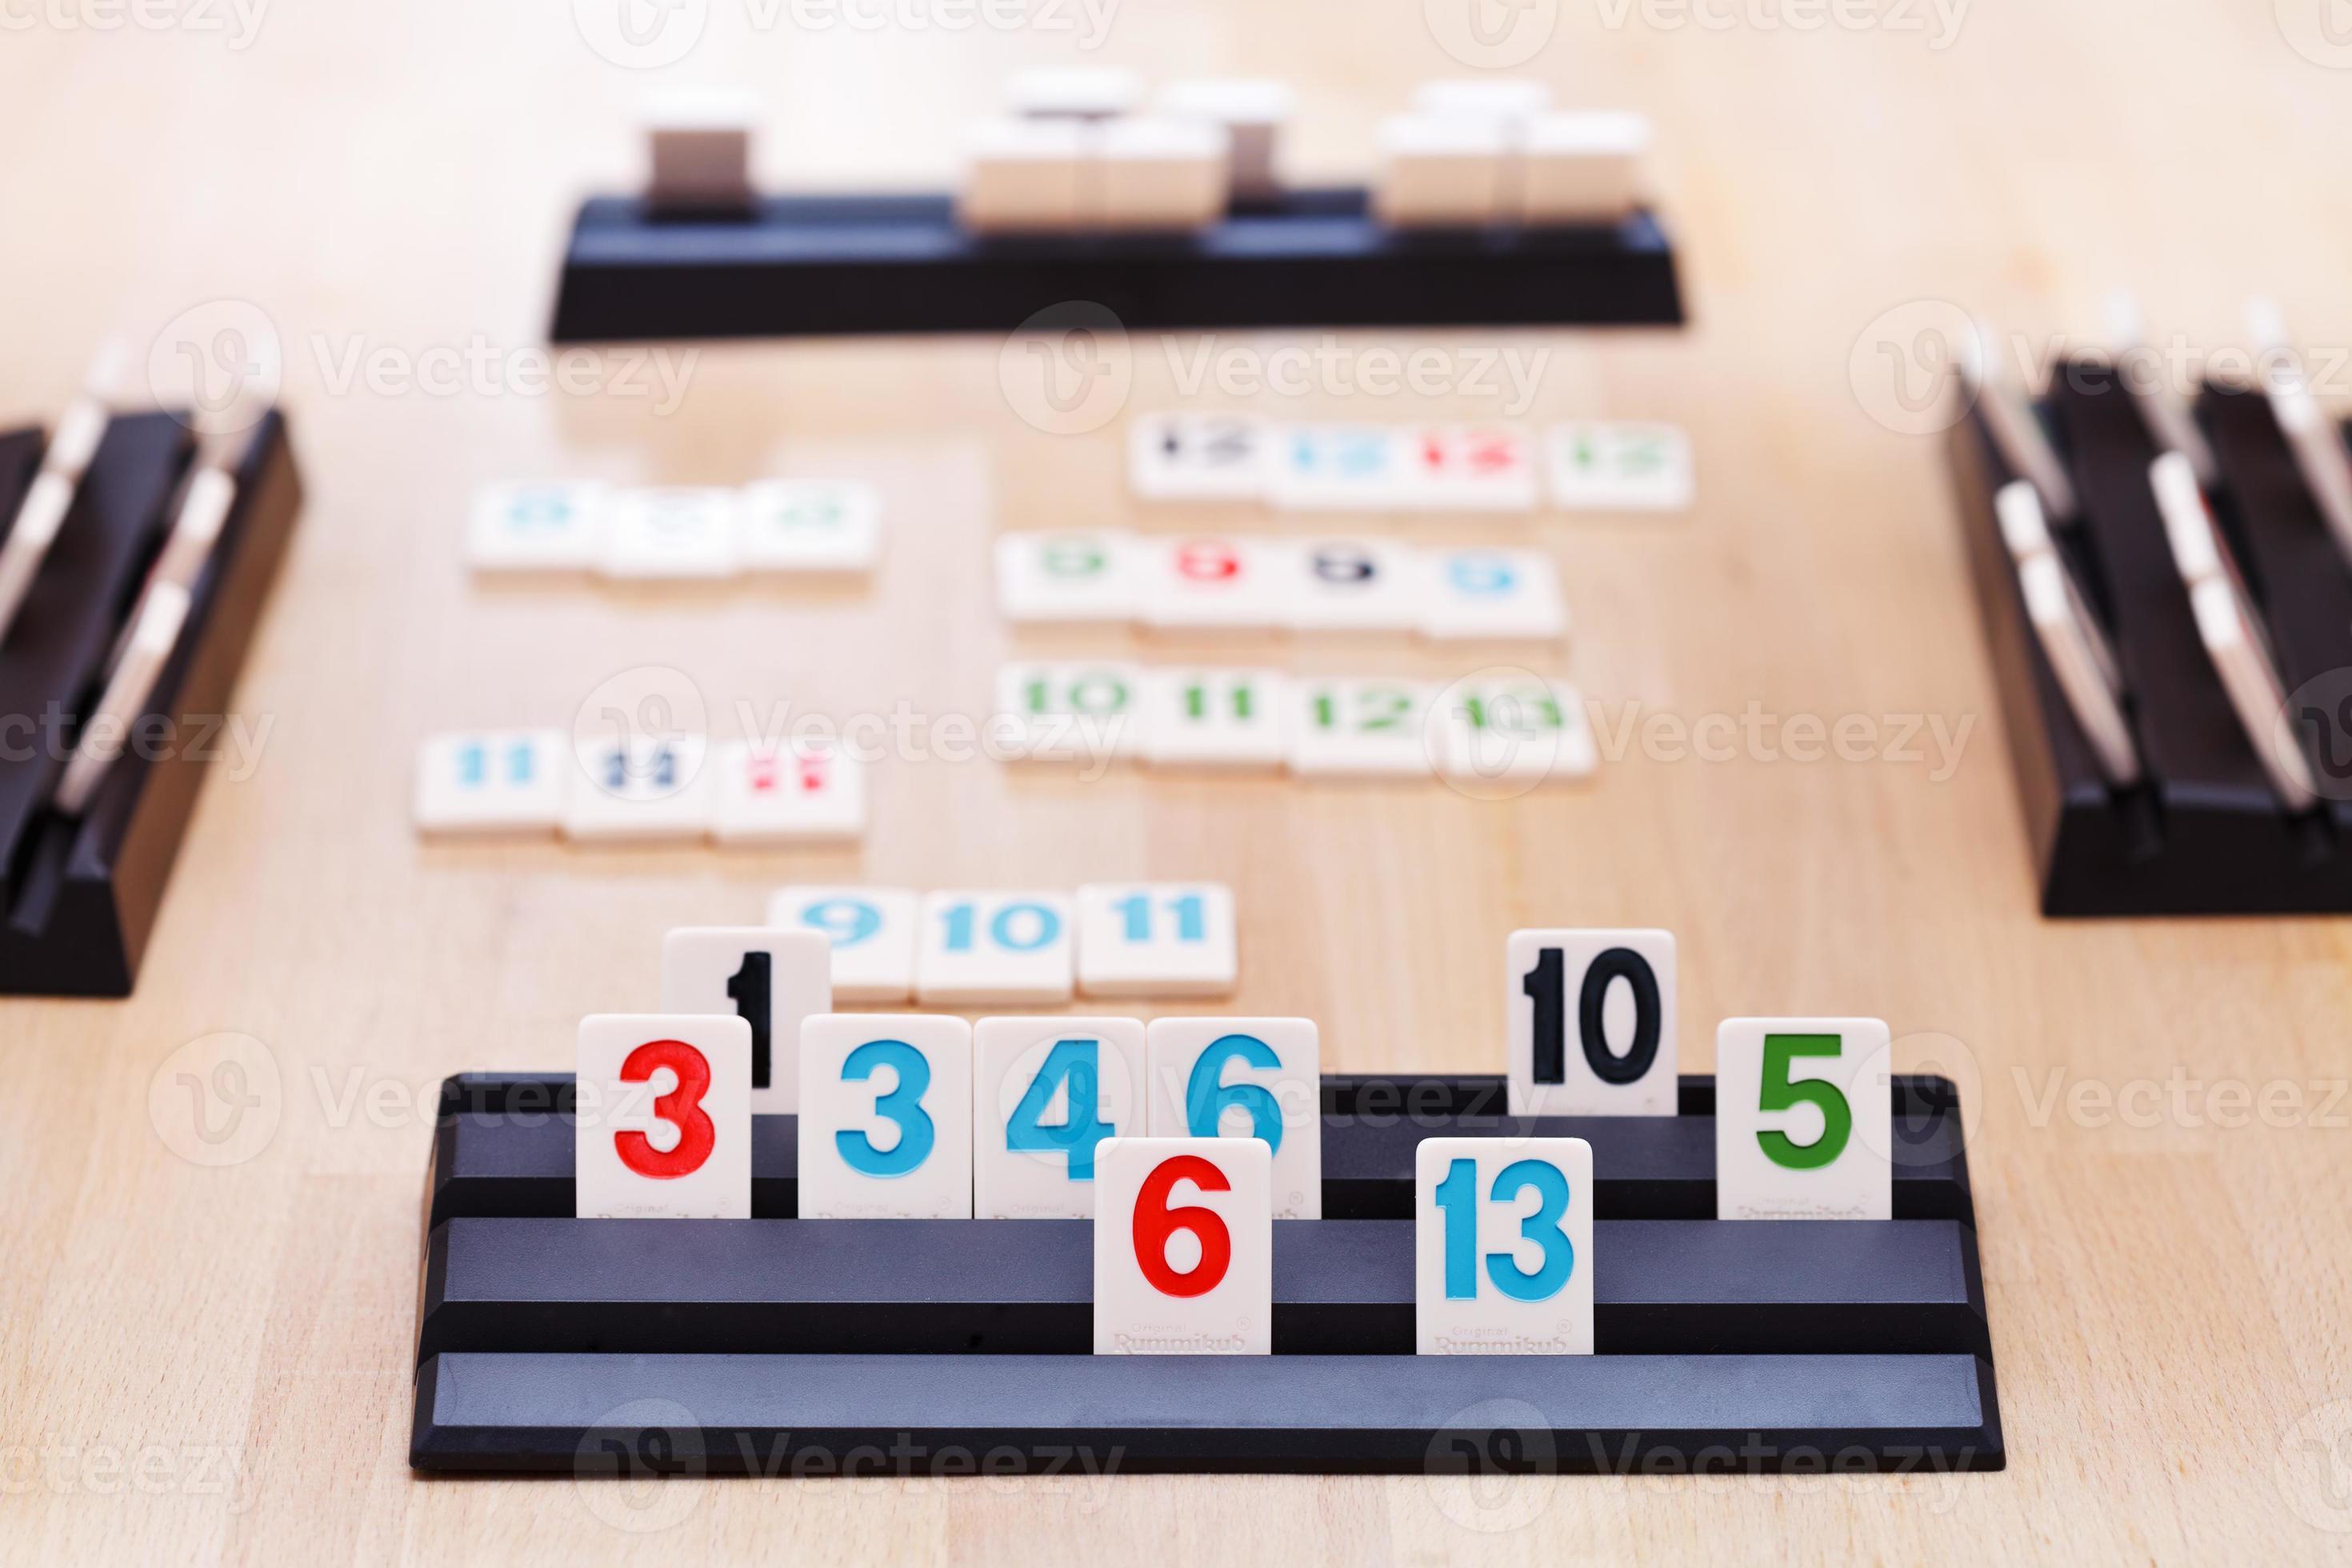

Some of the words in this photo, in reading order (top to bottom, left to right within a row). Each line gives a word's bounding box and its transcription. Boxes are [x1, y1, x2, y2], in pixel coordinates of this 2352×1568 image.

[1025, 680, 1128, 714] 10
[1184, 686, 1253, 720] 11
[1312, 692, 1411, 731] 12
[457, 744, 534, 786] 11
[802, 898, 882, 947] 9
[942, 904, 1061, 951] 10
[1114, 895, 1206, 942] 11
[727, 951, 771, 1089] 1
[1524, 947, 1662, 1086] 10
[614, 1039, 715, 1180] 3
[835, 1039, 934, 1178] 3
[1006, 1039, 1115, 1182] 4
[1186, 1034, 1282, 1160] 6
[1756, 1034, 1852, 1170] 5
[1132, 1154, 1232, 1298] 6
[1435, 1158, 1574, 1302] 13
[1113, 1334, 1246, 1354] Rummikub
[1131, 1323, 1186, 1334] Original
[1434, 1336, 1568, 1354] Rummikub
[1452, 1326, 1508, 1338] Original
